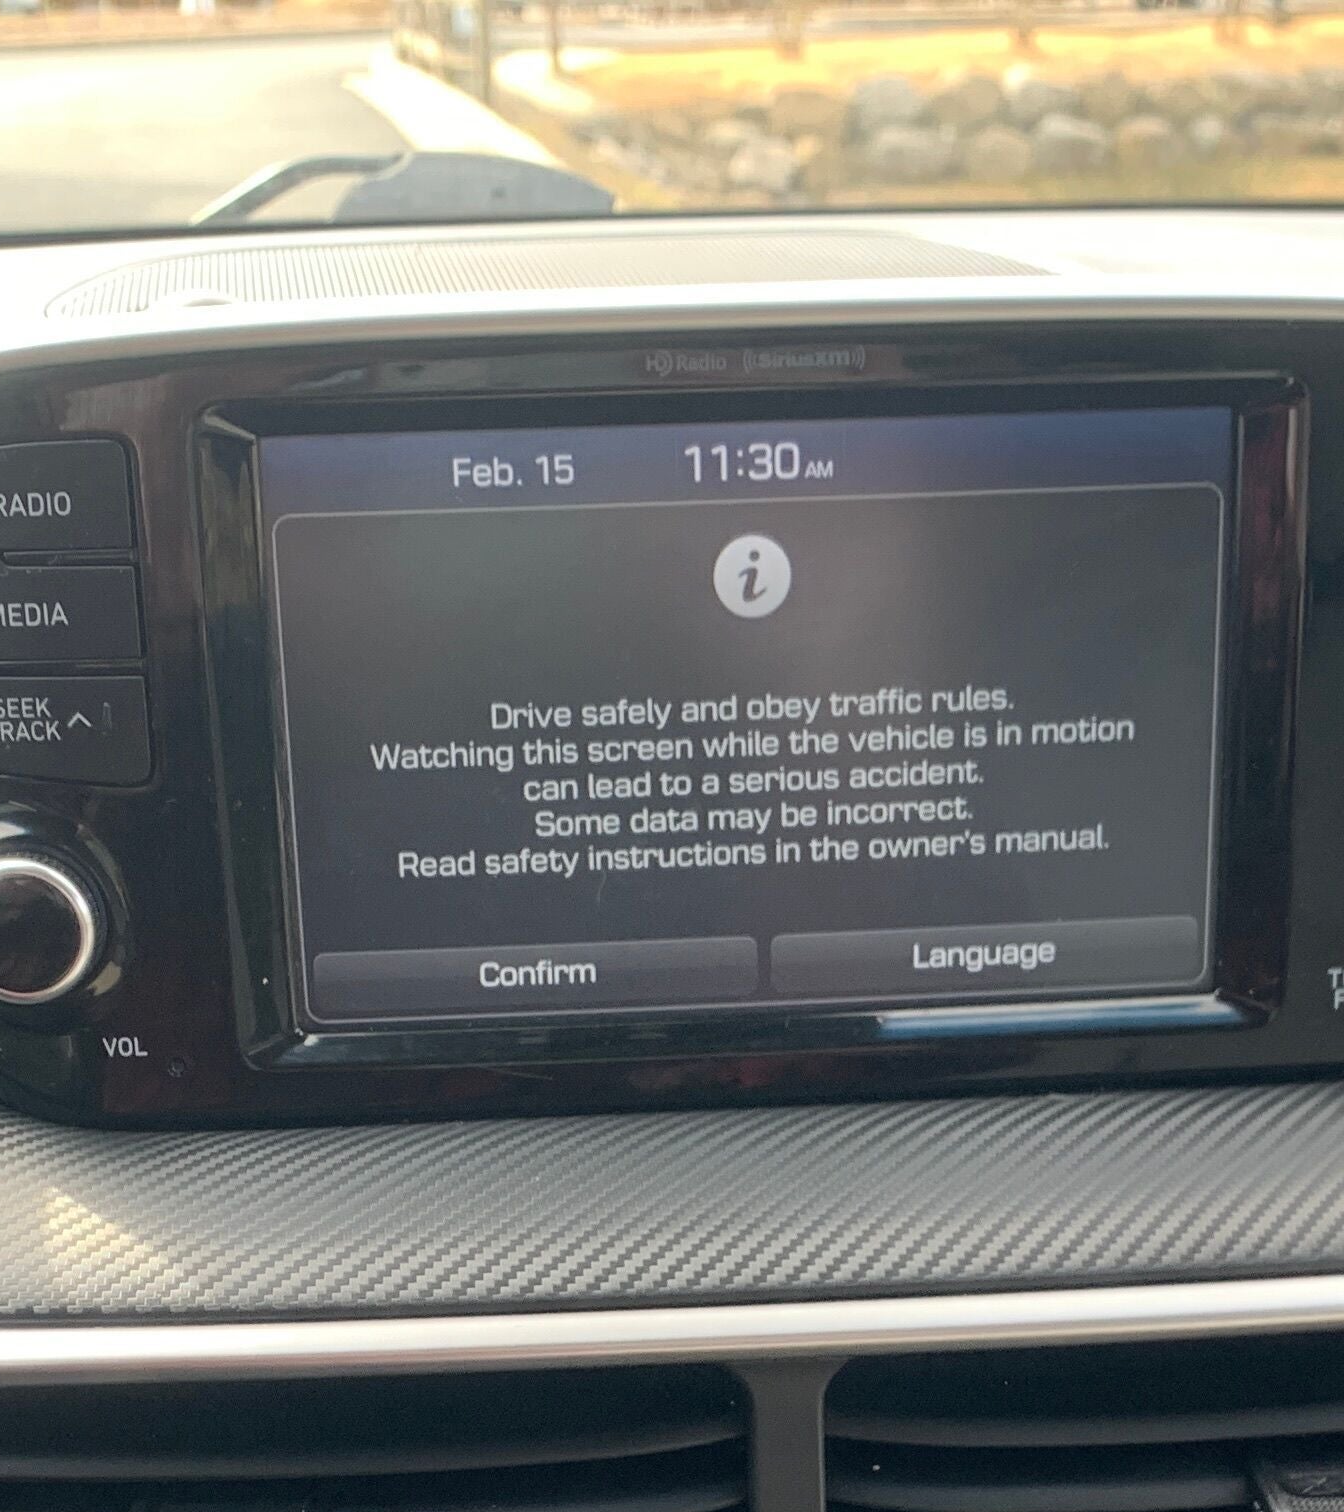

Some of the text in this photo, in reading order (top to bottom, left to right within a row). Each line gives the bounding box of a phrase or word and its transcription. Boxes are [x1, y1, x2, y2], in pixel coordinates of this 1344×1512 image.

[676, 353, 727, 372] Radio
[451, 453, 575, 488] Feb. 15
[684, 440, 834, 483] 11:30 AM
[491, 684, 1015, 730] Drive safely and obey traffic rules.
[370, 713, 1135, 772] Watching this screen while the vehicle is in motion
[523, 759, 984, 802] can lead to a serious accident.
[535, 796, 974, 837] Some data may be incorrect.
[398, 822, 1109, 879] Read safety instructions in the owner's manual.
[479, 958, 597, 989] Confirm
[912, 939, 1057, 973] Language
[102, 1036, 148, 1059] VOL
